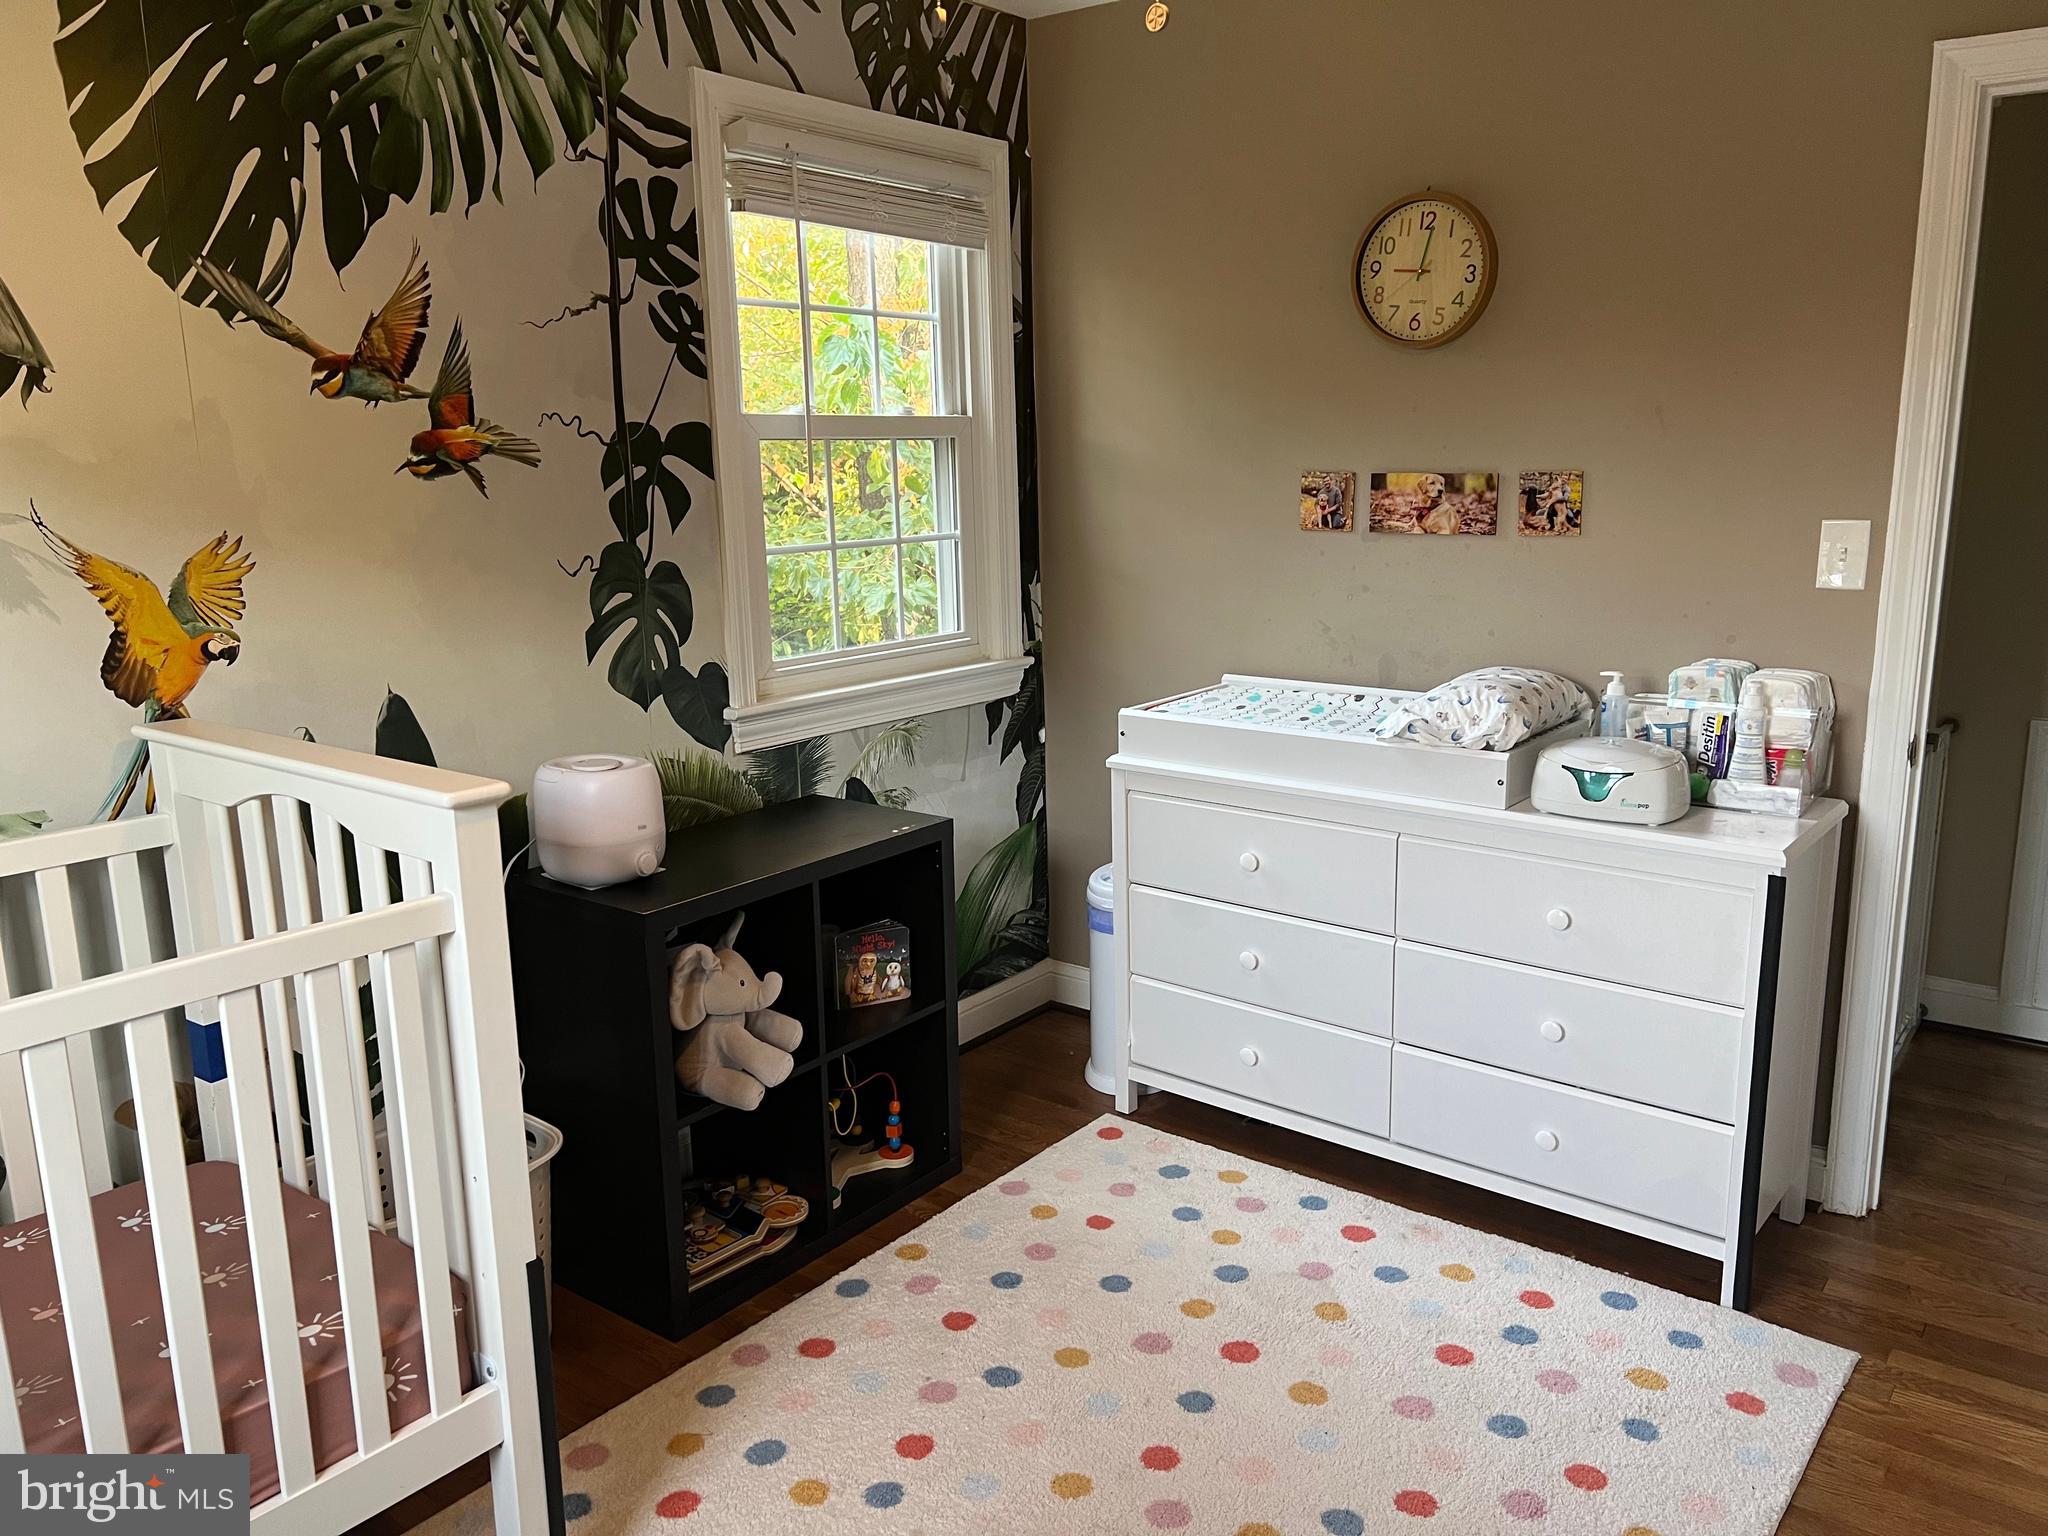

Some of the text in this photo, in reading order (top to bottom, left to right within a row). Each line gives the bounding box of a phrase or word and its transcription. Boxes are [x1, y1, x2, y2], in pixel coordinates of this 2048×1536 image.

[1399, 218, 1412, 237] 11
[1419, 211, 1437, 230] 12
[1449, 219, 1454, 238] 1
[1379, 236, 1396, 255] 10
[1459, 239, 1473, 258] 2
[1370, 260, 1382, 279] 9
[1464, 264, 1477, 283] 3
[1374, 286, 1385, 304] 8
[1451, 290, 1465, 308] 4
[1388, 305, 1400, 322] 7
[1408, 312, 1421, 331] 6
[1432, 306, 1446, 326] 5
[1698, 716, 1716, 764] Desitin
